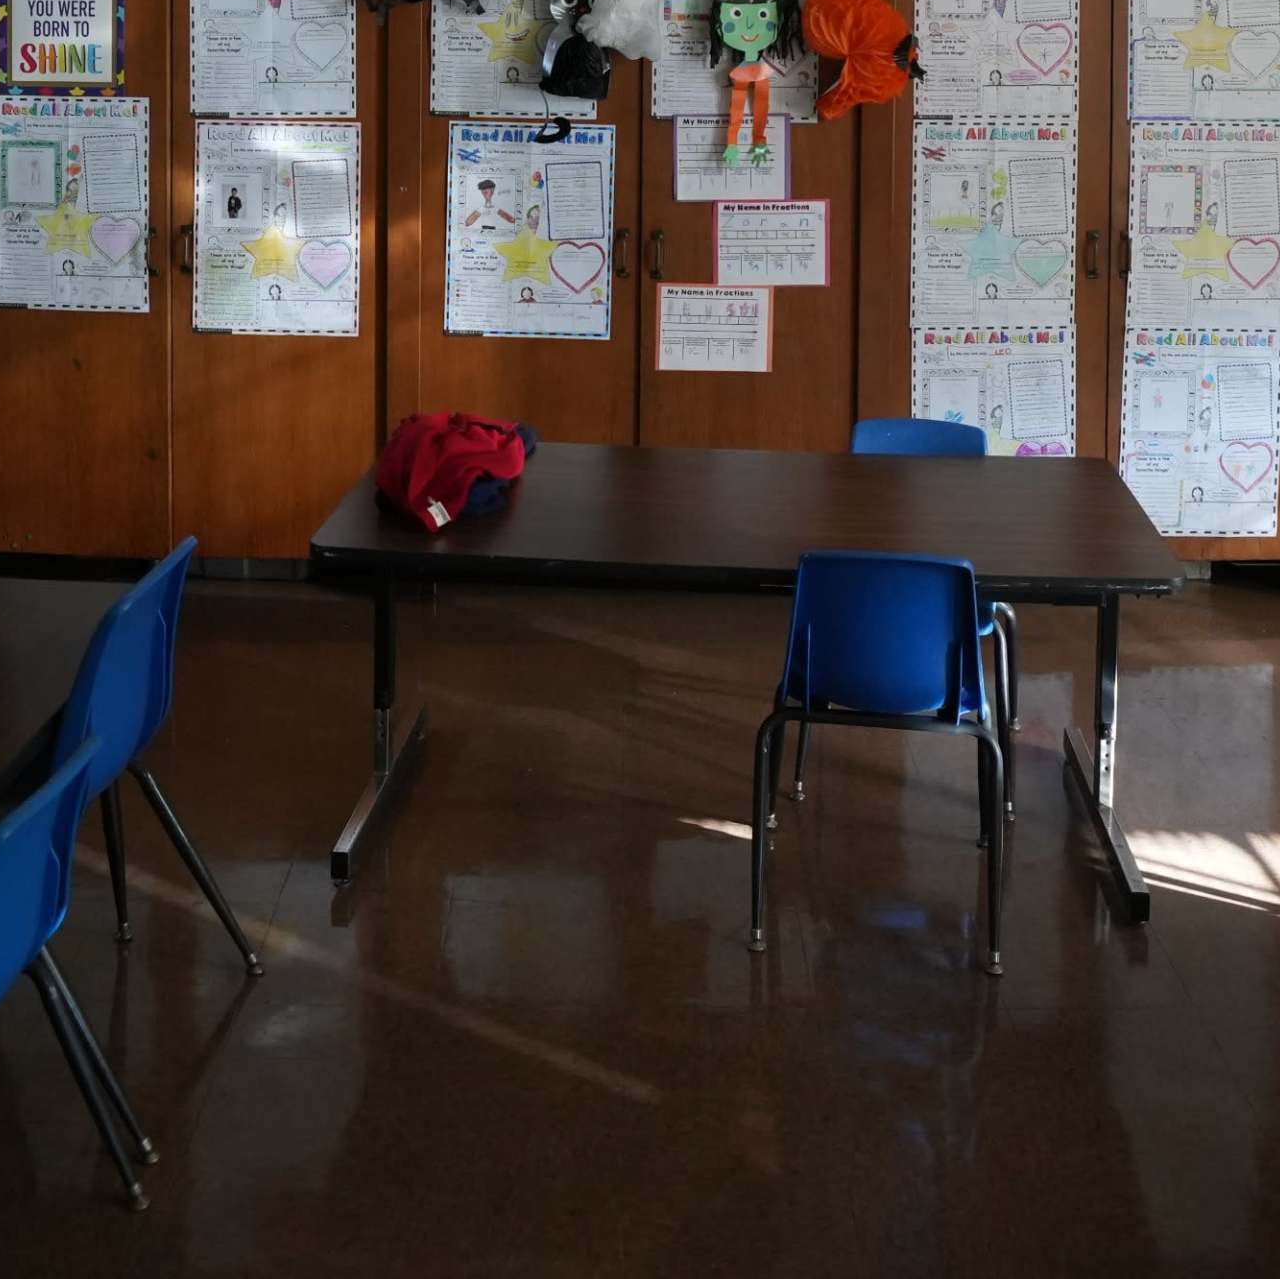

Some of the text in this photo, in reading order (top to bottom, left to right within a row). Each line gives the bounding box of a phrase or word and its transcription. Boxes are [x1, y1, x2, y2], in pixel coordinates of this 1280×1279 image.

[27, 0, 96, 17] YOU WERE
[33, 21, 90, 37] BORN TO
[20, 43, 103, 74] SHINE
[461, 129, 498, 142] Read
[502, 129, 523, 142] All
[926, 127, 963, 140] Read
[965, 127, 987, 140] All
[990, 128, 1035, 141] About
[723, 204, 736, 212] My
[716, 289, 753, 297] Fractions
[924, 332, 961, 344] Read
[964, 332, 986, 344] All
[988, 331, 1033, 344] About
[1136, 333, 1172, 346] Read
[1175, 333, 1196, 346] All
[1200, 333, 1244, 346] About
